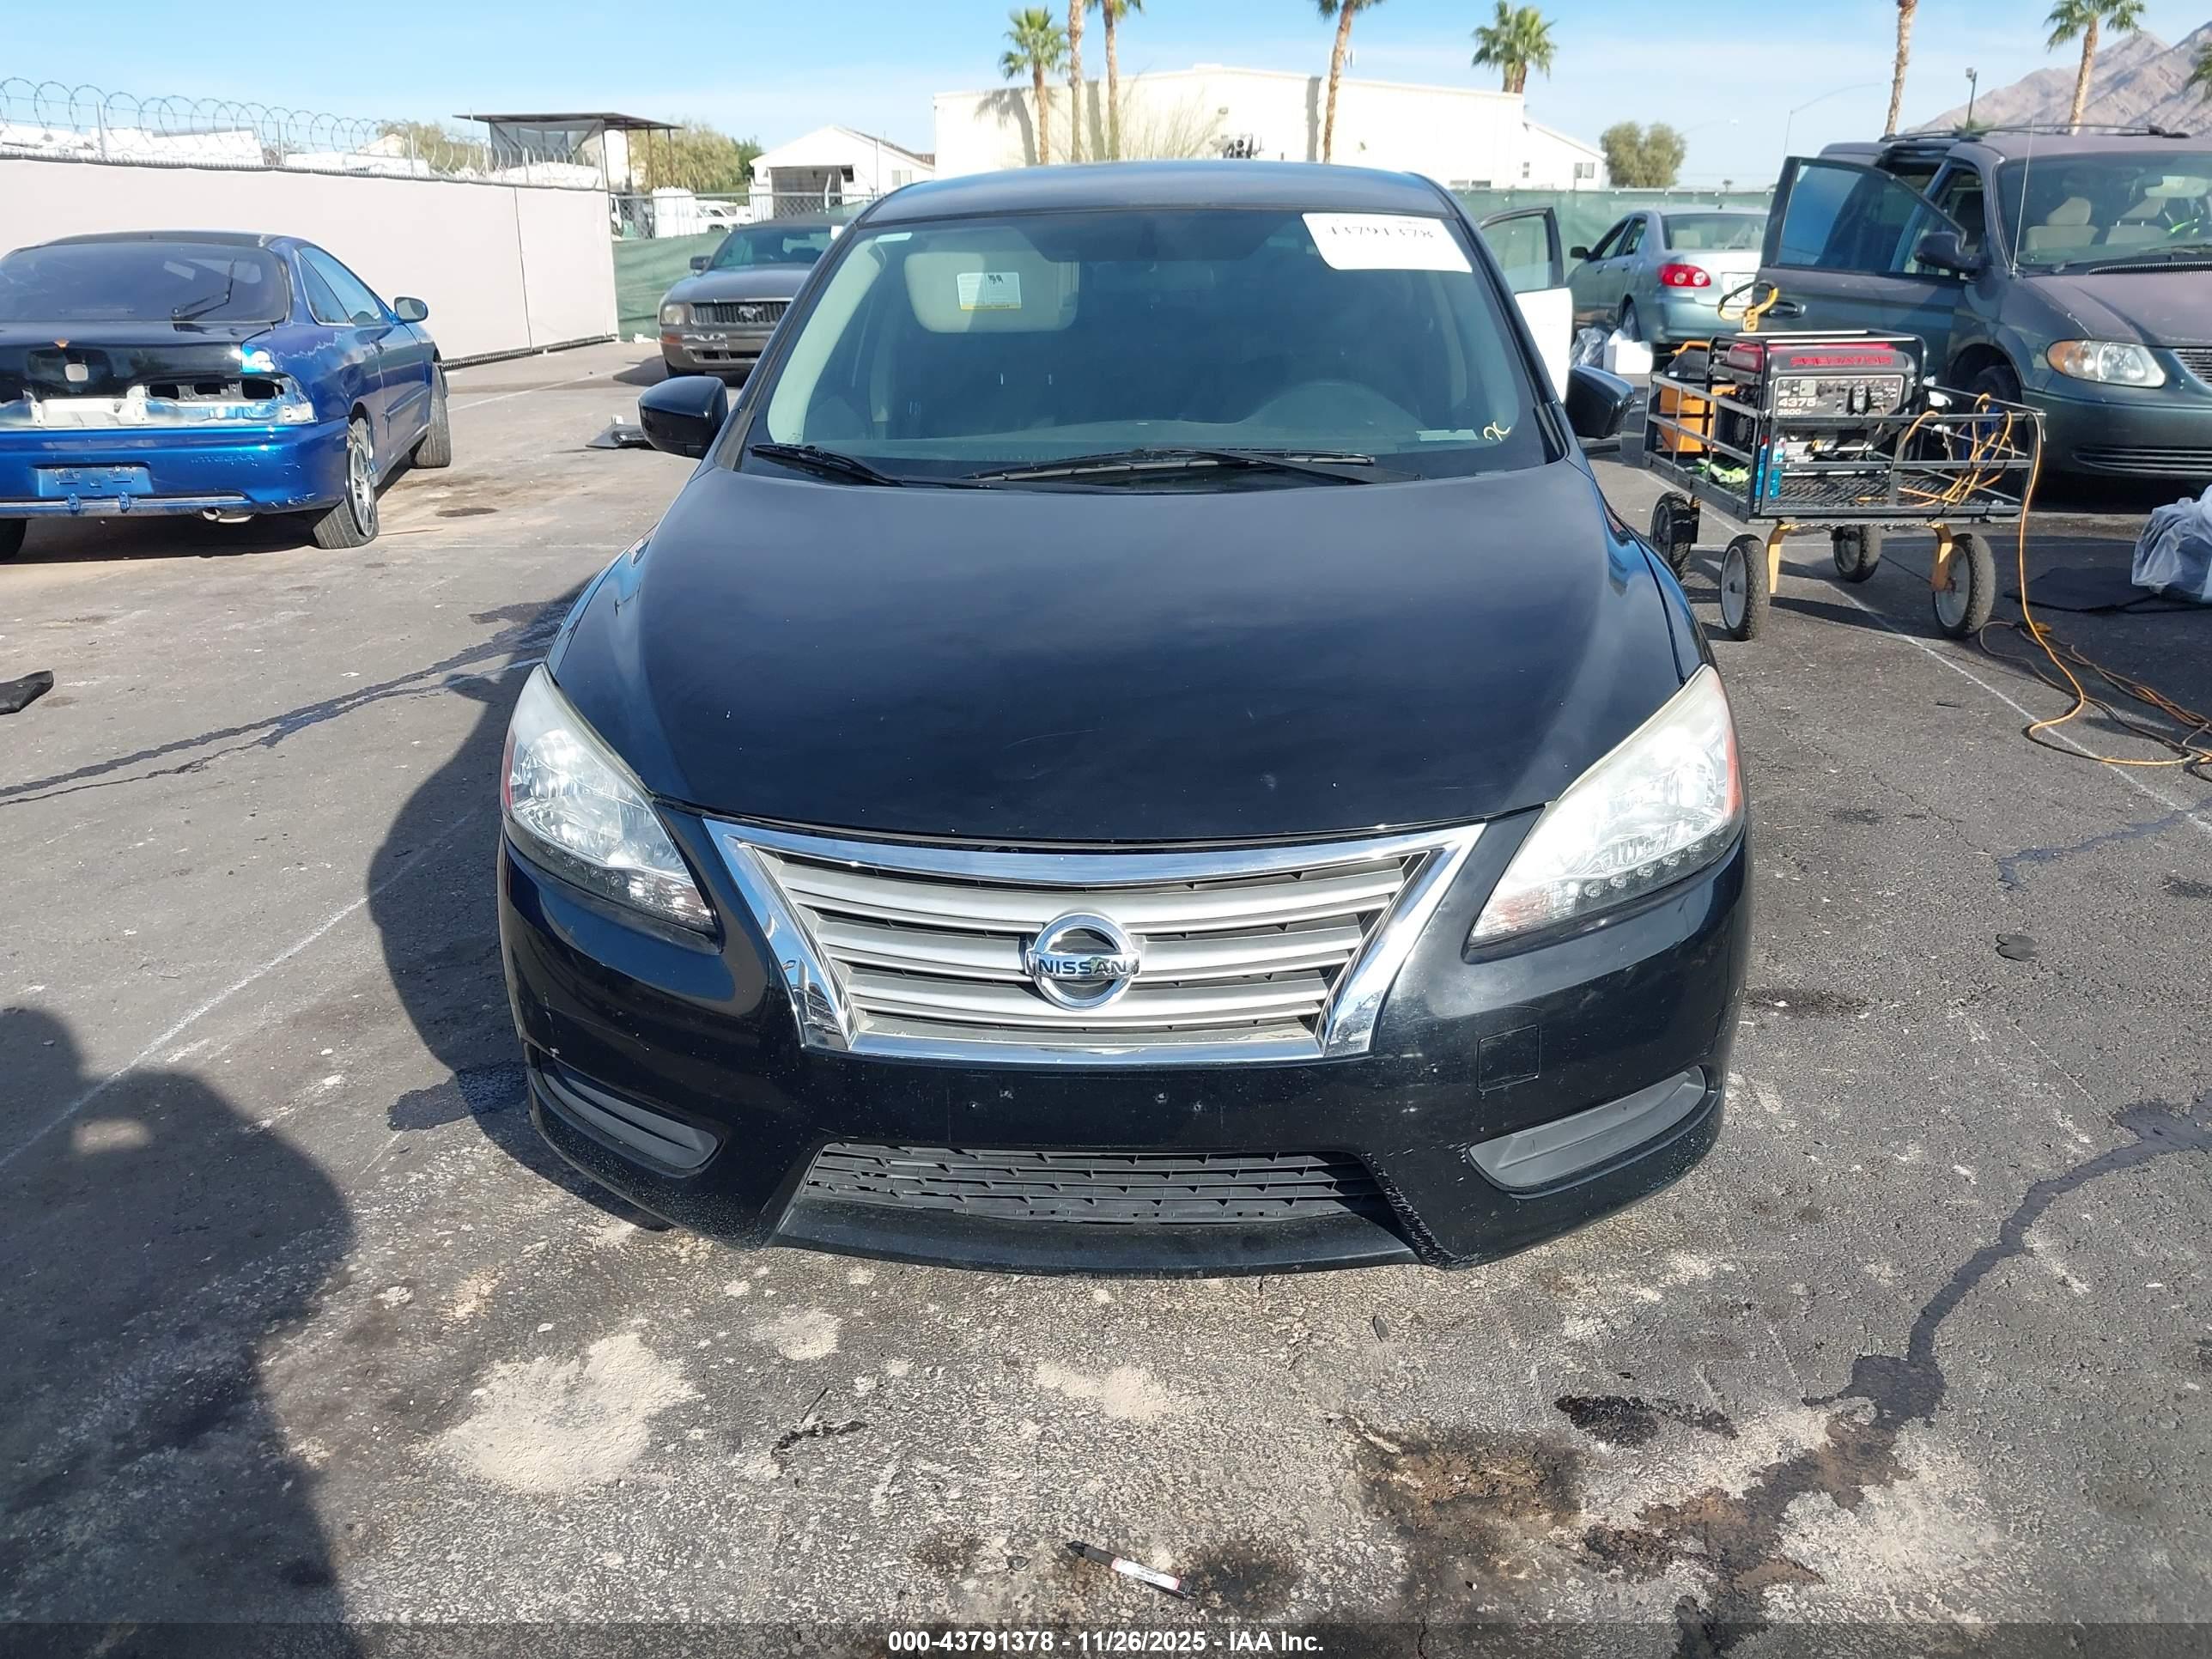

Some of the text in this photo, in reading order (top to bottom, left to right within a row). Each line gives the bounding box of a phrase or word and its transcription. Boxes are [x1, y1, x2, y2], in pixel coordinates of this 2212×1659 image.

[1790, 356, 1894, 368] PREDATOR
[1778, 397, 1817, 407] 4375
[1037, 957, 1127, 976] NISSAN
